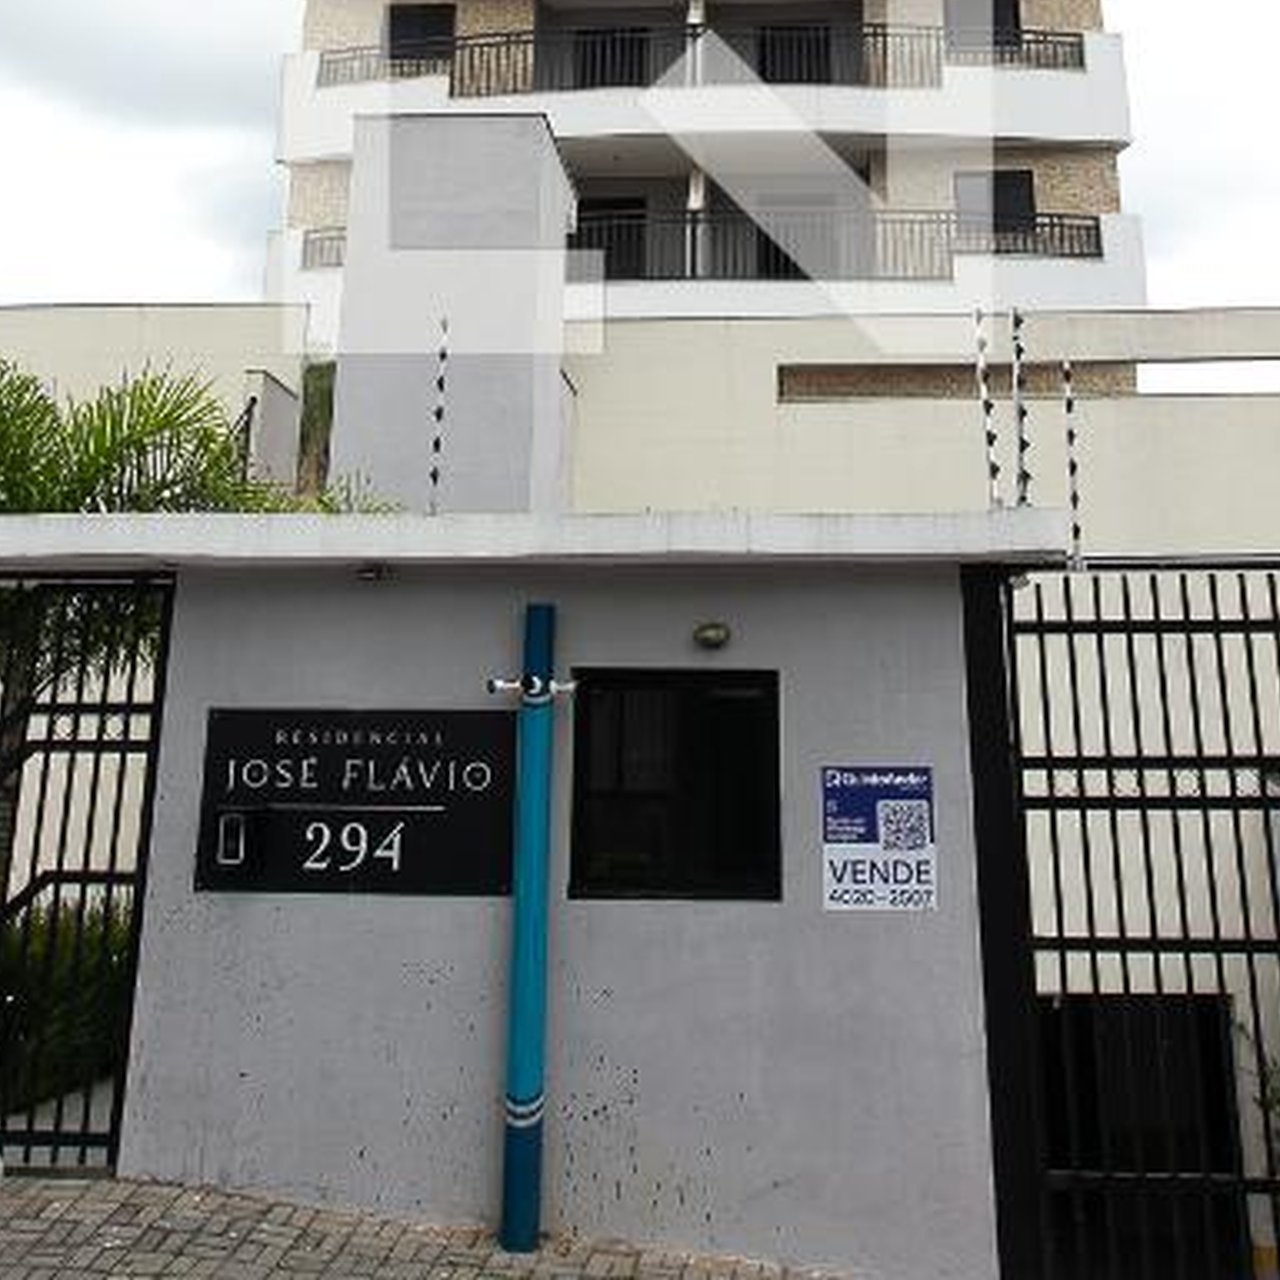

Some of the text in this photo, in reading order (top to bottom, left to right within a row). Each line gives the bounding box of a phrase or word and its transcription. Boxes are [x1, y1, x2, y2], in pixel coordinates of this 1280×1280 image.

[275, 729, 442, 745] RESIDENCIAL
[227, 756, 491, 792] JOSÉ FLÁVIO
[303, 822, 405, 871] 294
[828, 859, 933, 885] VENDE
